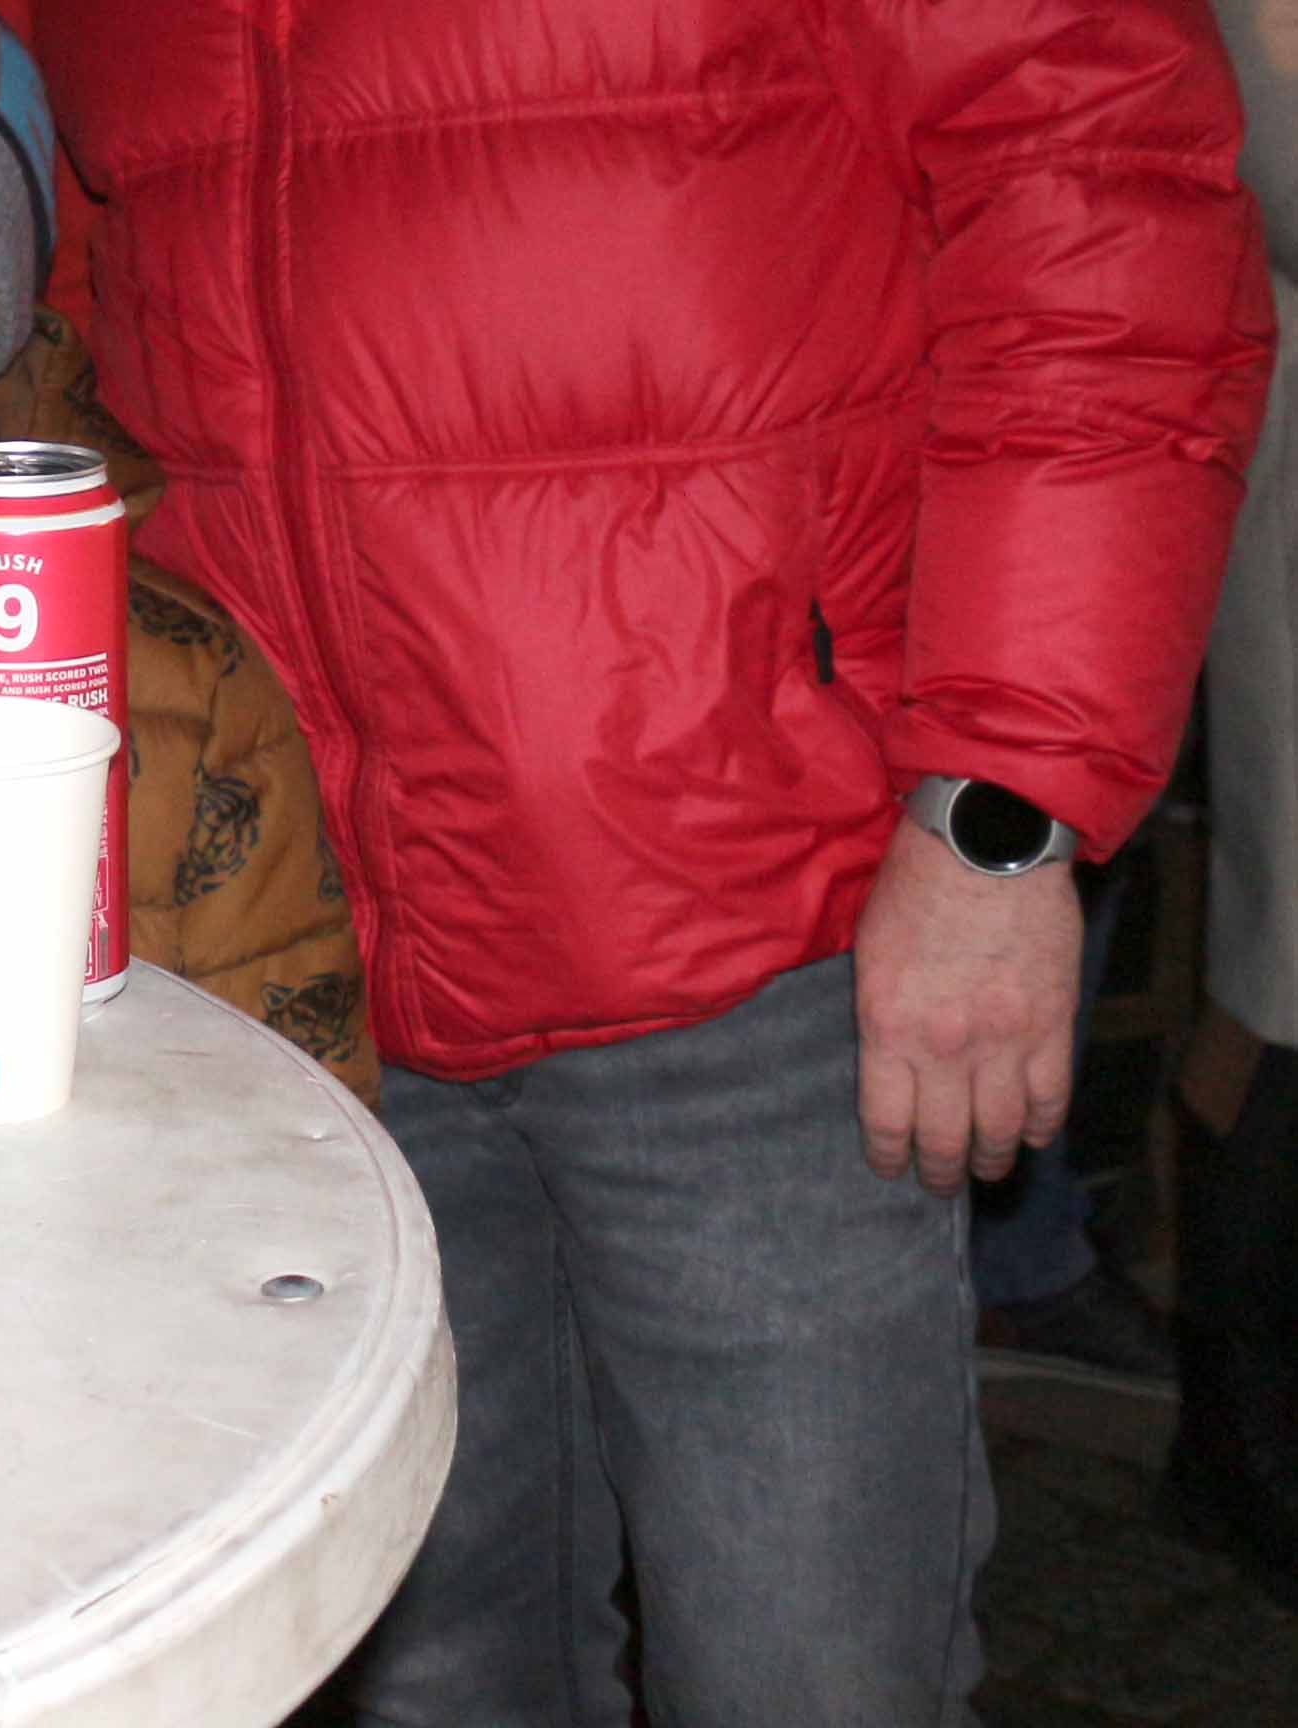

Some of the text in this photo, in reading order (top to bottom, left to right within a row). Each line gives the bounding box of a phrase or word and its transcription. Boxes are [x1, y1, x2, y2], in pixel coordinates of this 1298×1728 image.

[11, 673, 44, 684] RUSH
[45, 667, 86, 682] SCORED
[1, 685, 23, 695] AND
[25, 685, 51, 695] RUSH
[52, 680, 87, 693] SCORED
[67, 688, 108, 708] RUSH
